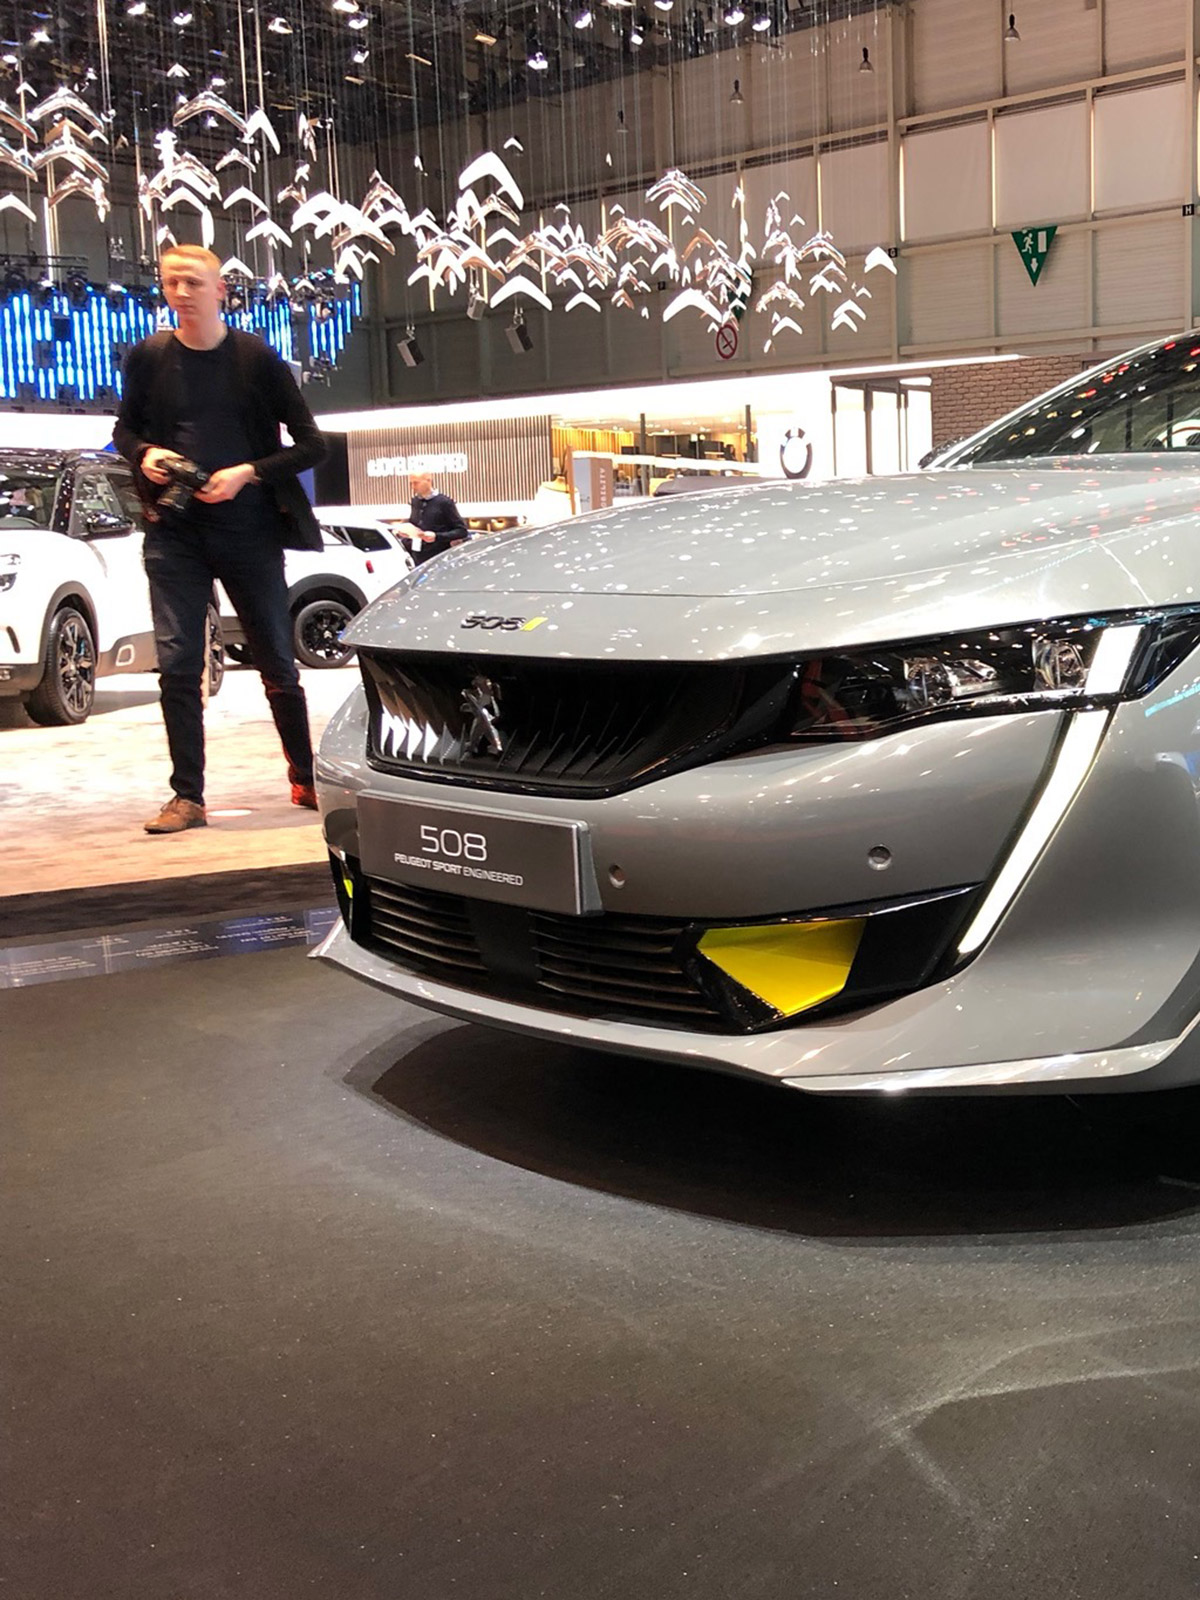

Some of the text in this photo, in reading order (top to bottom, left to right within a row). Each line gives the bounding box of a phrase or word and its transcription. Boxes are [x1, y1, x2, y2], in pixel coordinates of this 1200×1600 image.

[599, 467, 607, 508] OBILITY
[421, 825, 487, 861] 508
[394, 853, 523, 886] PEUGEOT SPORT ENGINEERED
